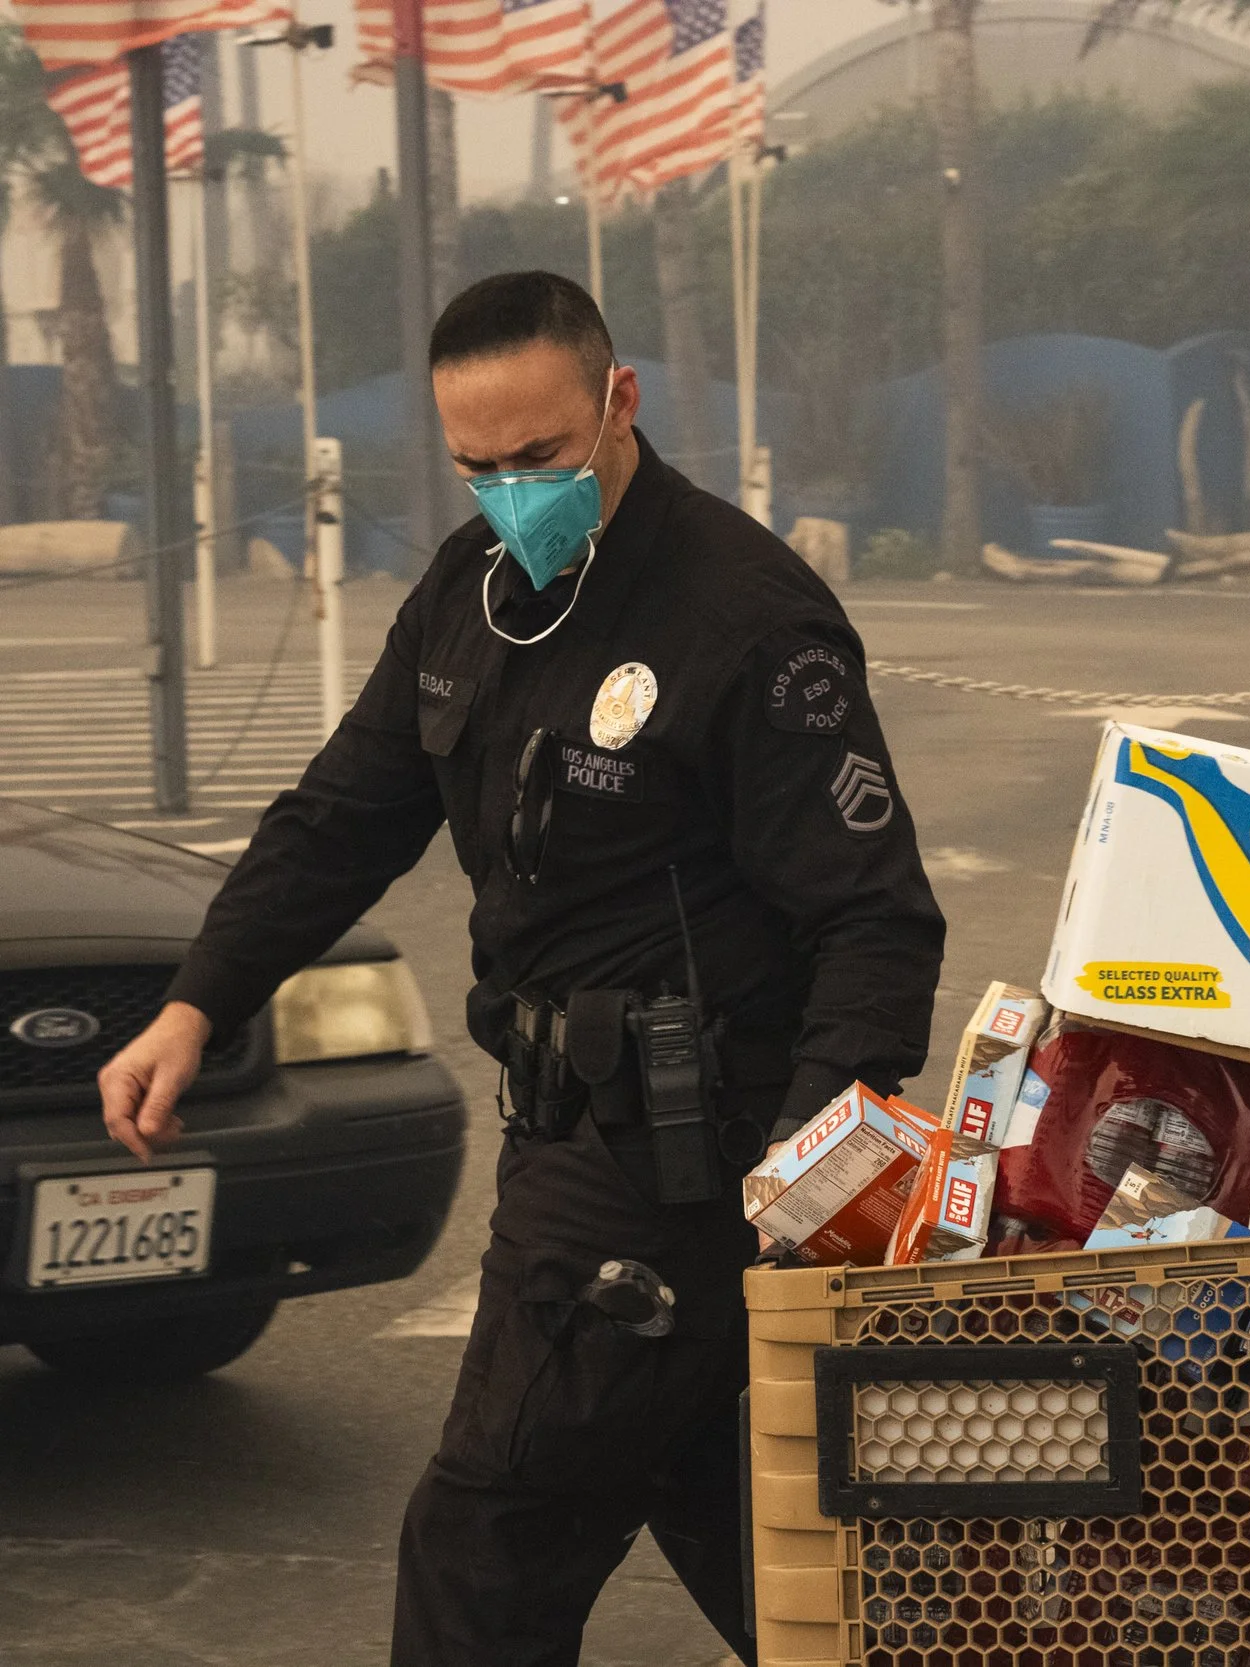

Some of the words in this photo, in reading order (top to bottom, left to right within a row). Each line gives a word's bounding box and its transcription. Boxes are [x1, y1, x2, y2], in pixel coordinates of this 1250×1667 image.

[419, 672, 454, 697] ELBAZ
[771, 673, 790, 707] LOS
[788, 649, 846, 675] ANGELES
[803, 678, 831, 701] ESD
[806, 695, 849, 727] POLICE
[562, 746, 582, 764] LOS
[584, 753, 635, 776] ANGELES
[567, 764, 625, 793] POLICE
[1098, 970, 1160, 981] SELECTED
[1164, 971, 1219, 983] QUALITY
[1103, 985, 1156, 1000] CLASS
[1161, 986, 1217, 1001] EXTRA
[995, 1010, 1021, 1031] CLIF
[946, 1106, 956, 1128] COLATE
[952, 1068, 963, 1106] MACADAMIA
[801, 1115, 840, 1156] CLIF
[963, 1103, 988, 1140] LIF
[861, 1127, 882, 1144] Nutrition
[881, 1141, 896, 1154] Facts
[949, 1181, 973, 1217] CLIF
[948, 1212, 969, 1223] BAR
[43, 1209, 199, 1270] 1221685
